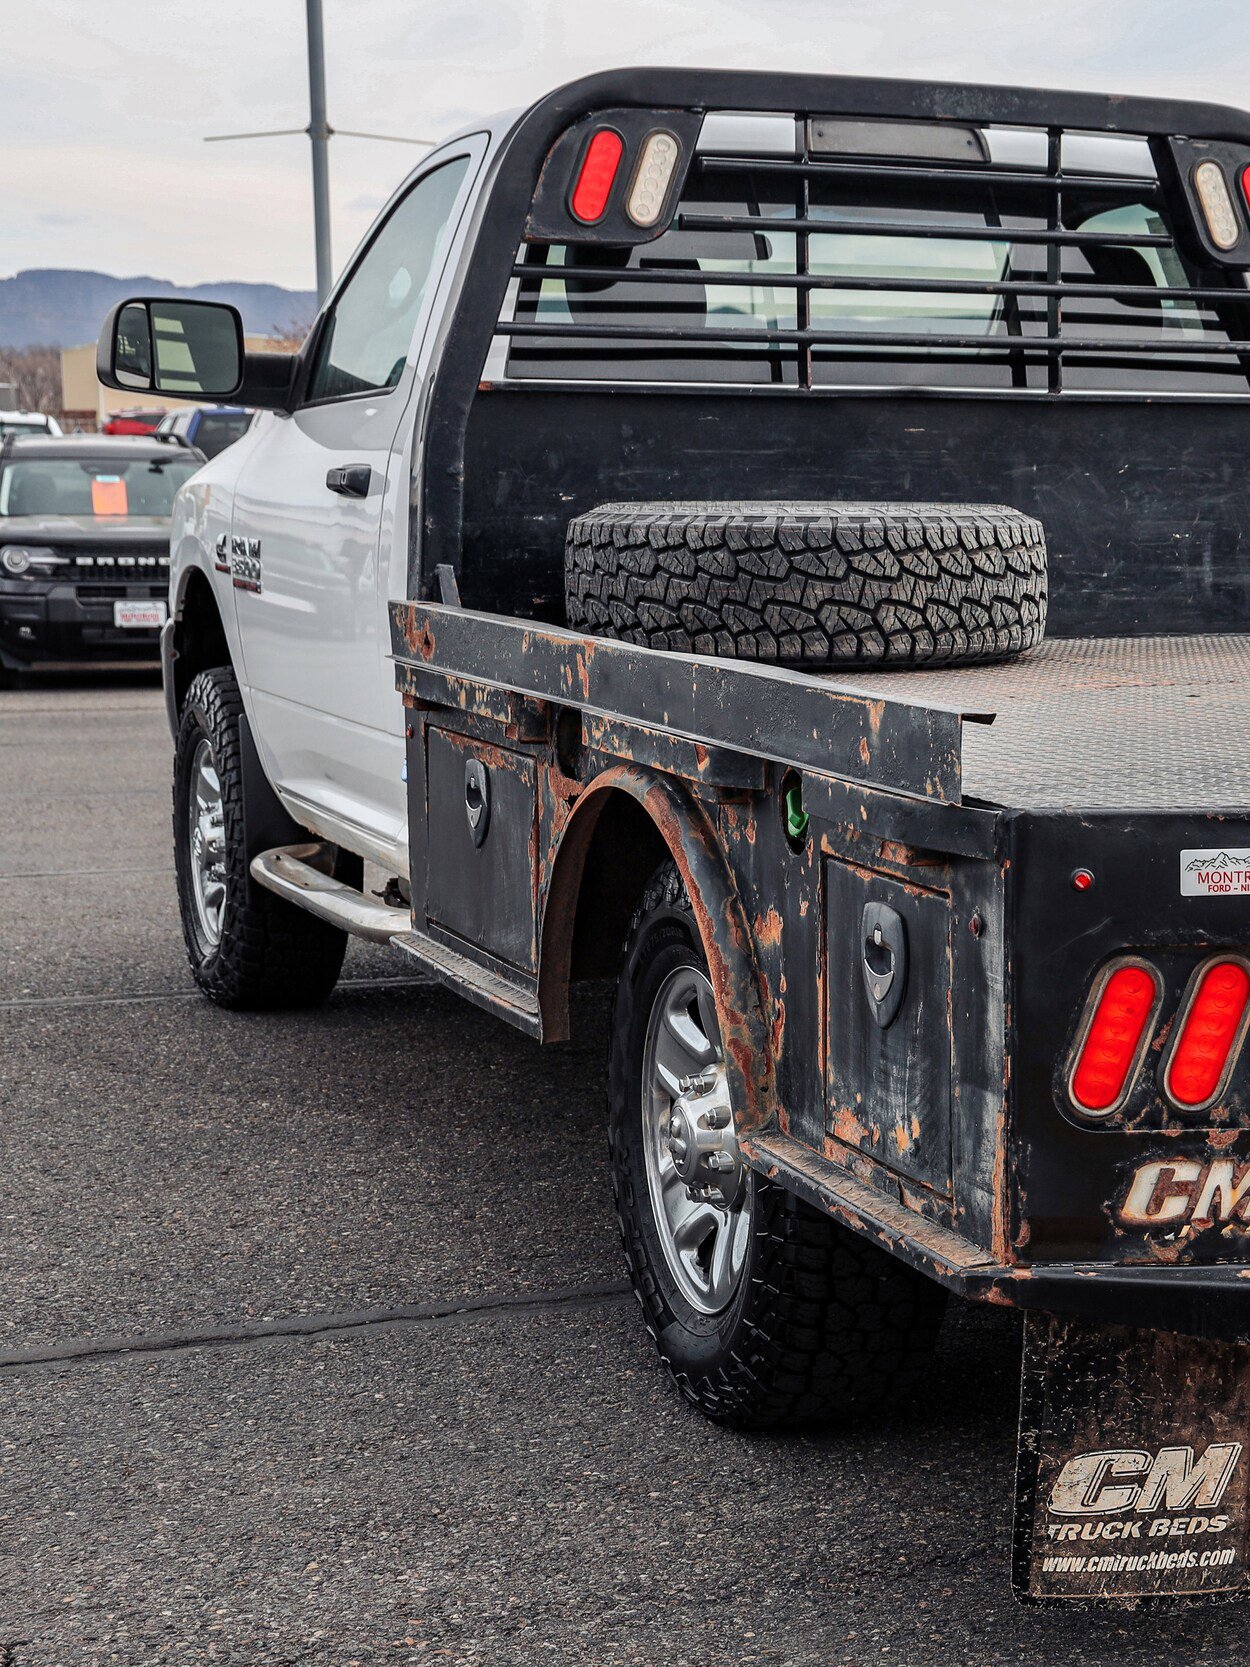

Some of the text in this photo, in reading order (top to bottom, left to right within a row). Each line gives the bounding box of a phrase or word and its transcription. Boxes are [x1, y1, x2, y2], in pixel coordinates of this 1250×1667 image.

[1207, 884, 1232, 893] FORD
[1047, 1441, 1243, 1516] CM
[1048, 1514, 1229, 1542] TRUCK BEDS
